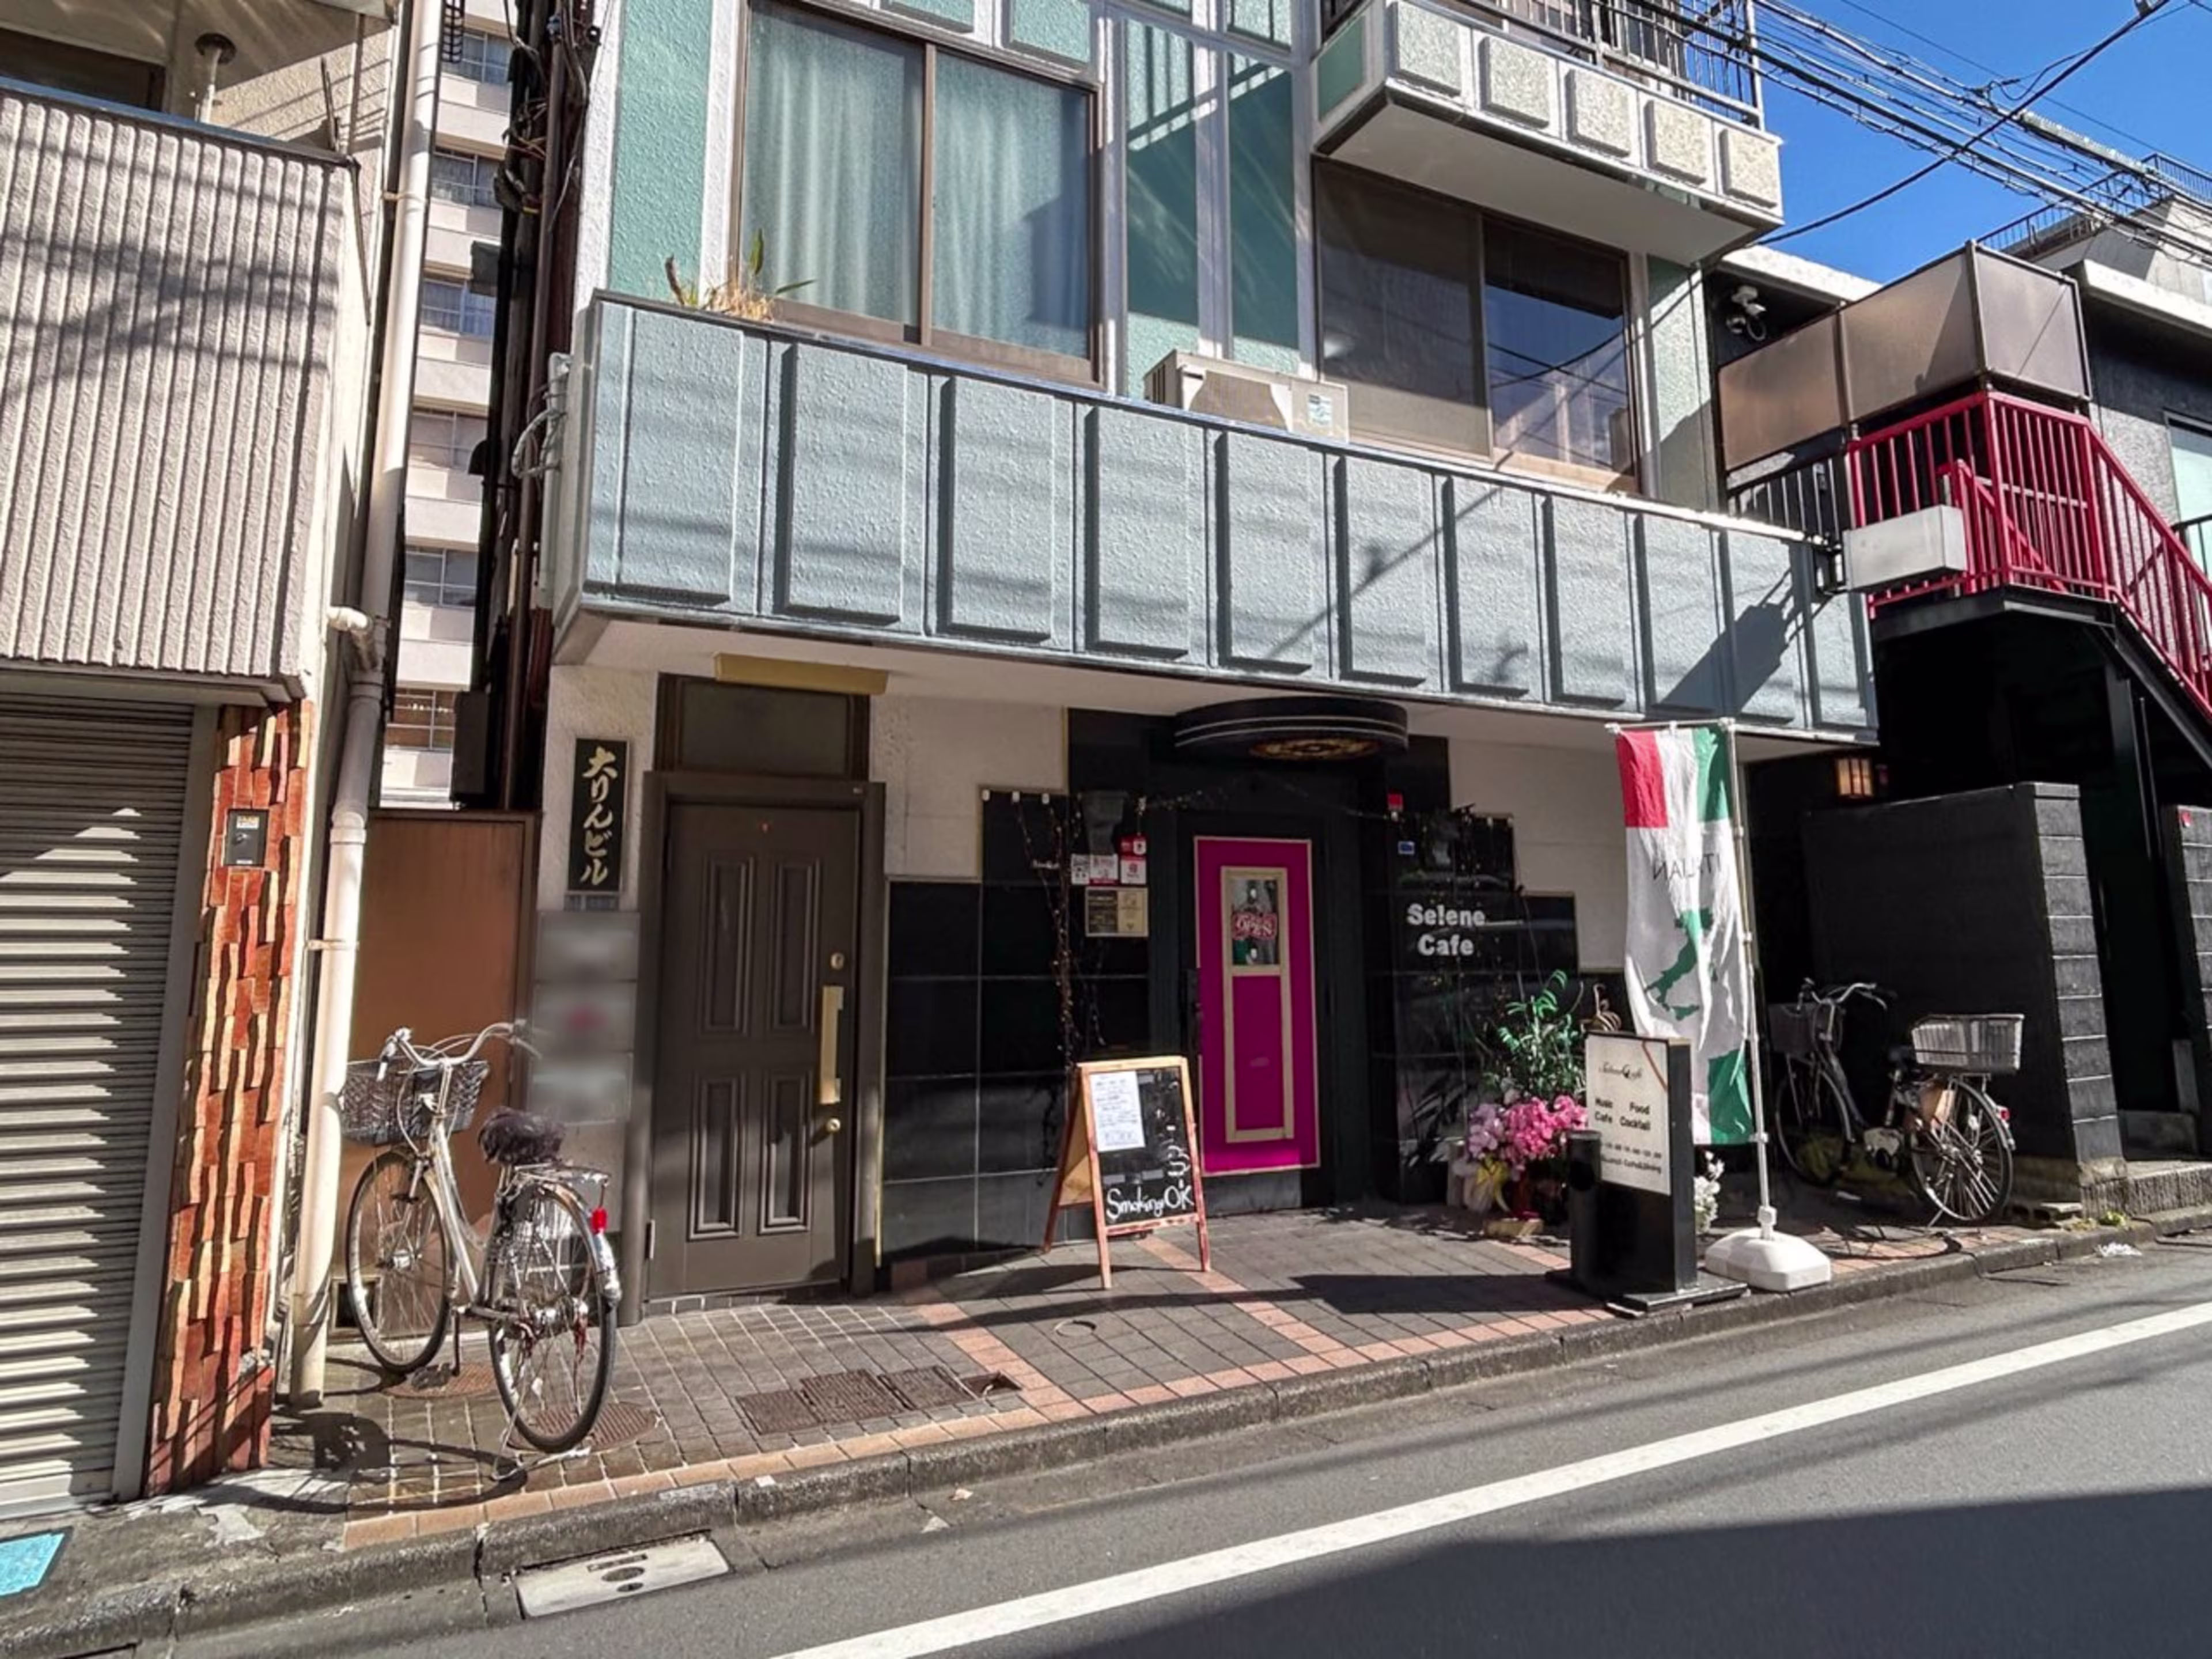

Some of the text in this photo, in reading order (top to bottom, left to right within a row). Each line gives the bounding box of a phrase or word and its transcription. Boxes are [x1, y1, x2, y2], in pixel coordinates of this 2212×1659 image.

[1407, 903, 1485, 927] Selene
[1236, 916, 1272, 935] OPEN
[1418, 934, 1474, 956] Cafe
[1630, 1101, 1650, 1115] Food
[1620, 1116, 1650, 1130] Cocktail
[1106, 1186, 1164, 1220] Smoking
